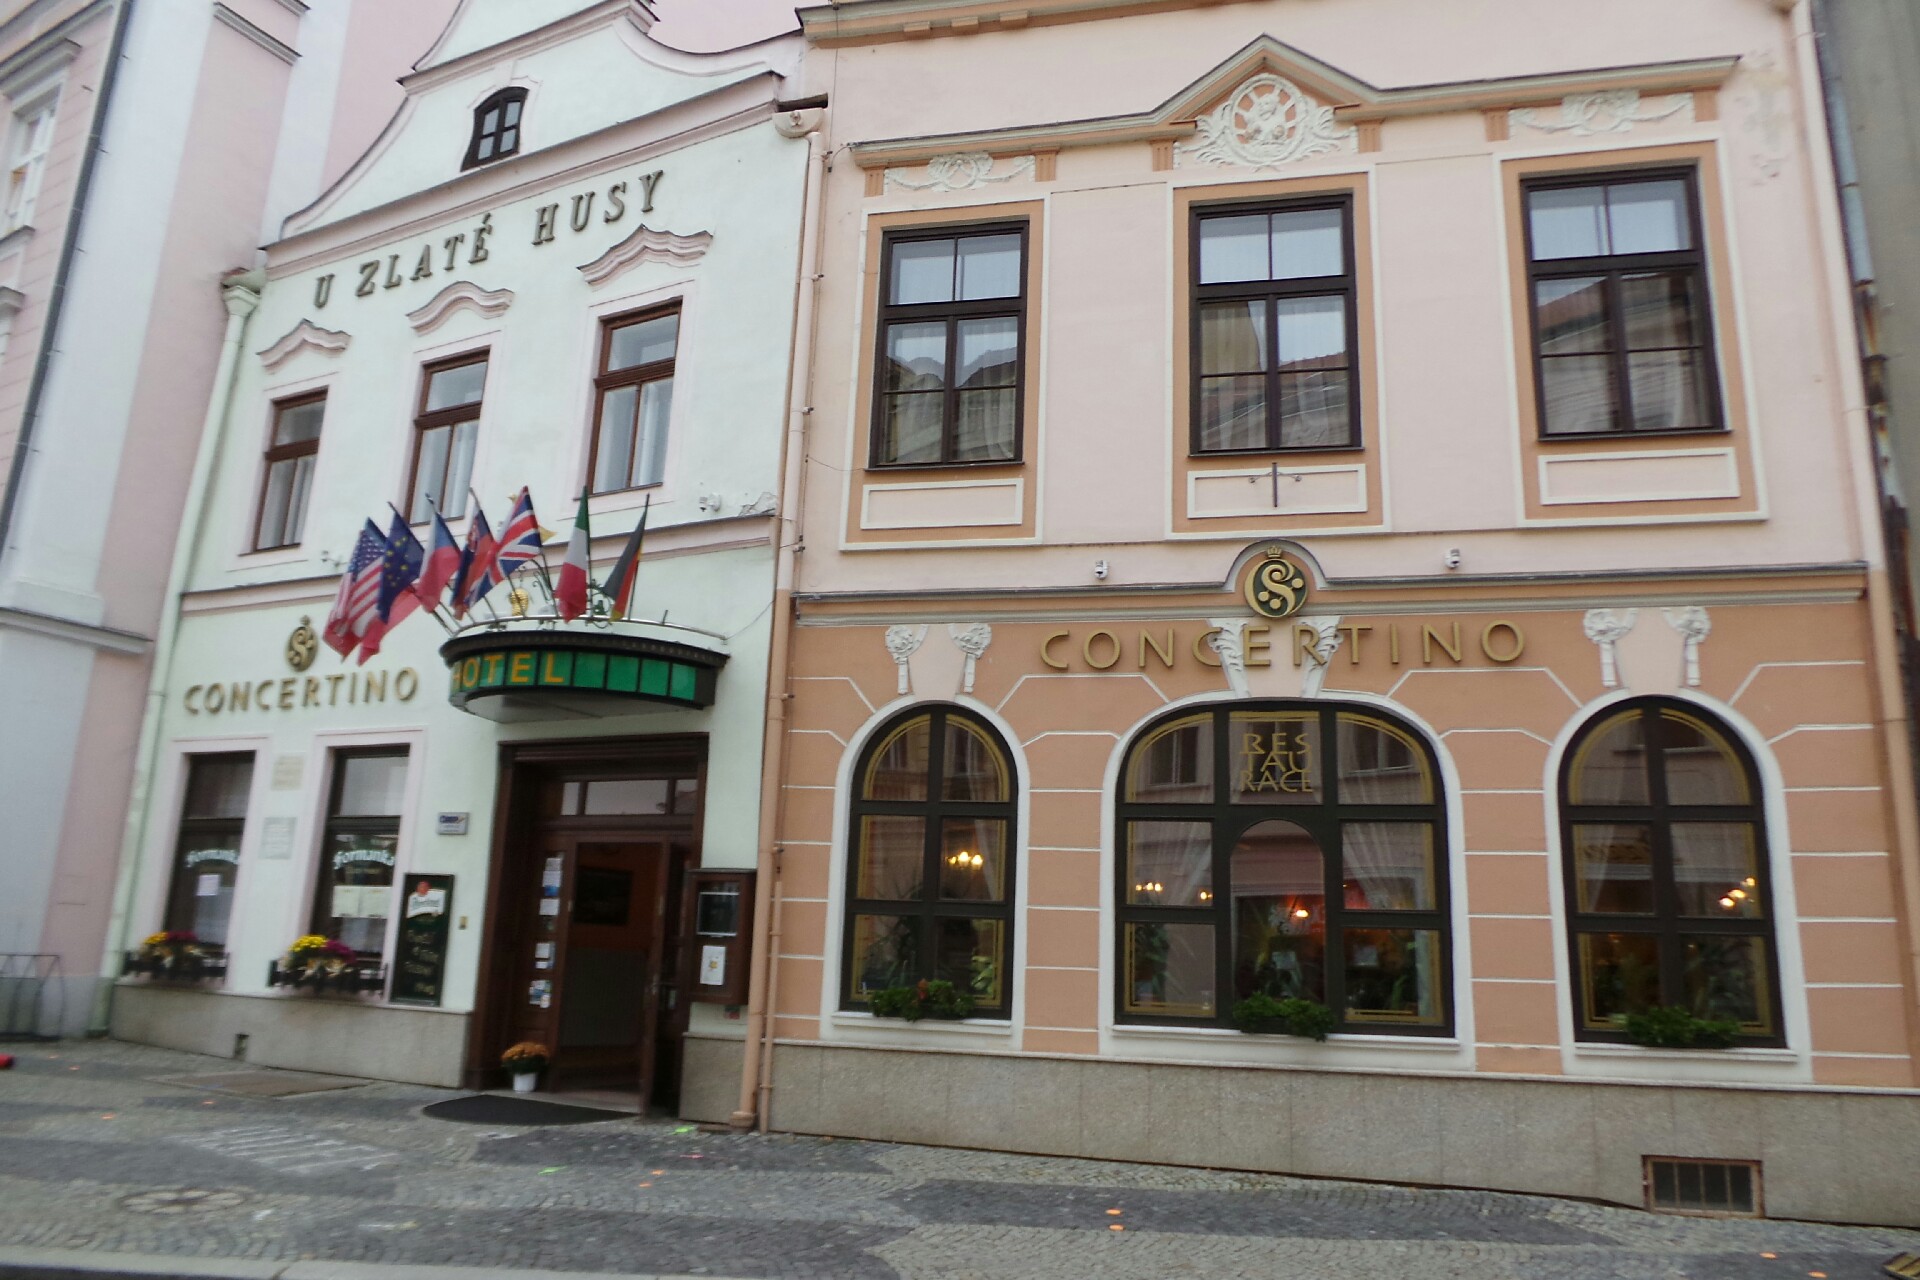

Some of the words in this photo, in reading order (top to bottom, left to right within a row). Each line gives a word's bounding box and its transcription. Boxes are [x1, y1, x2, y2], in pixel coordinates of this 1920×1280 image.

[314, 272, 336, 310] U
[355, 212, 493, 298] ZLATÉ
[531, 169, 665, 246] HUSY
[1039, 619, 1526, 670] CONCERTINO
[452, 652, 564, 688] HOTEL
[184, 666, 419, 715] CONCERTINO
[1240, 732, 1313, 755] RES
[1240, 750, 1313, 773] TAU
[1240, 769, 1314, 793] RACE
